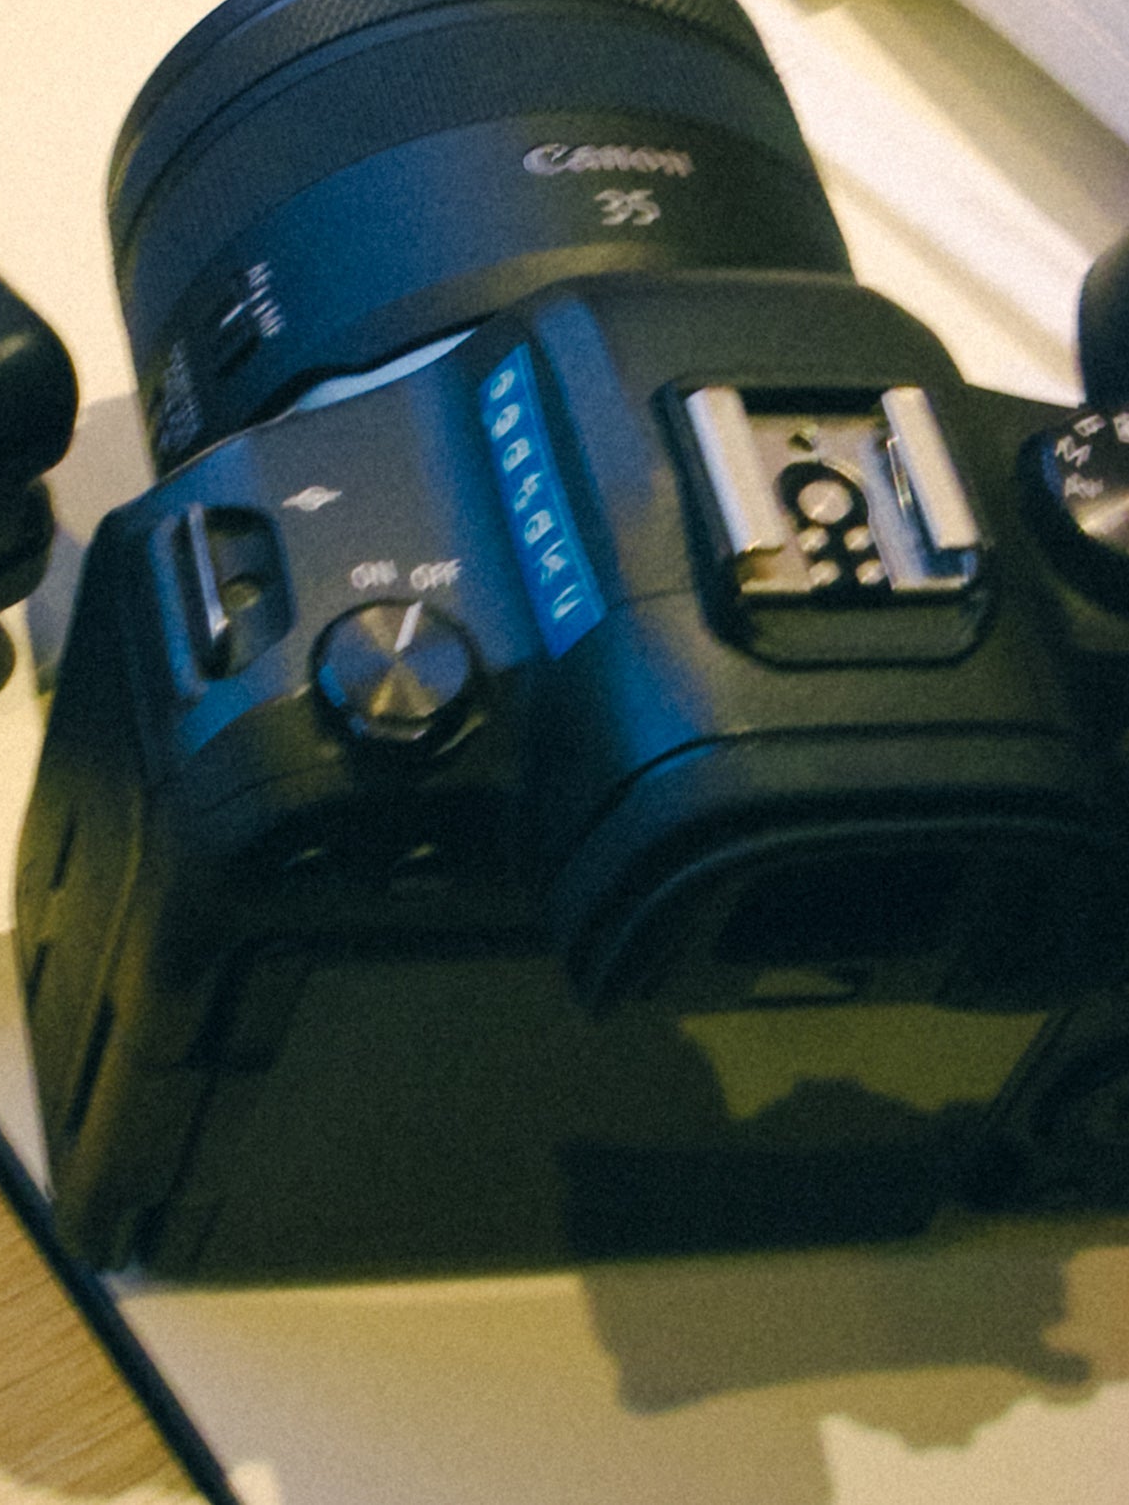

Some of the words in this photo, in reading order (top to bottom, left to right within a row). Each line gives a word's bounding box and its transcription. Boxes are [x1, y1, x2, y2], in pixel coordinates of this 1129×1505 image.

[523, 144, 694, 178] Canon
[595, 189, 661, 225] 35
[351, 559, 398, 590] ON
[410, 558, 462, 591] OFF
